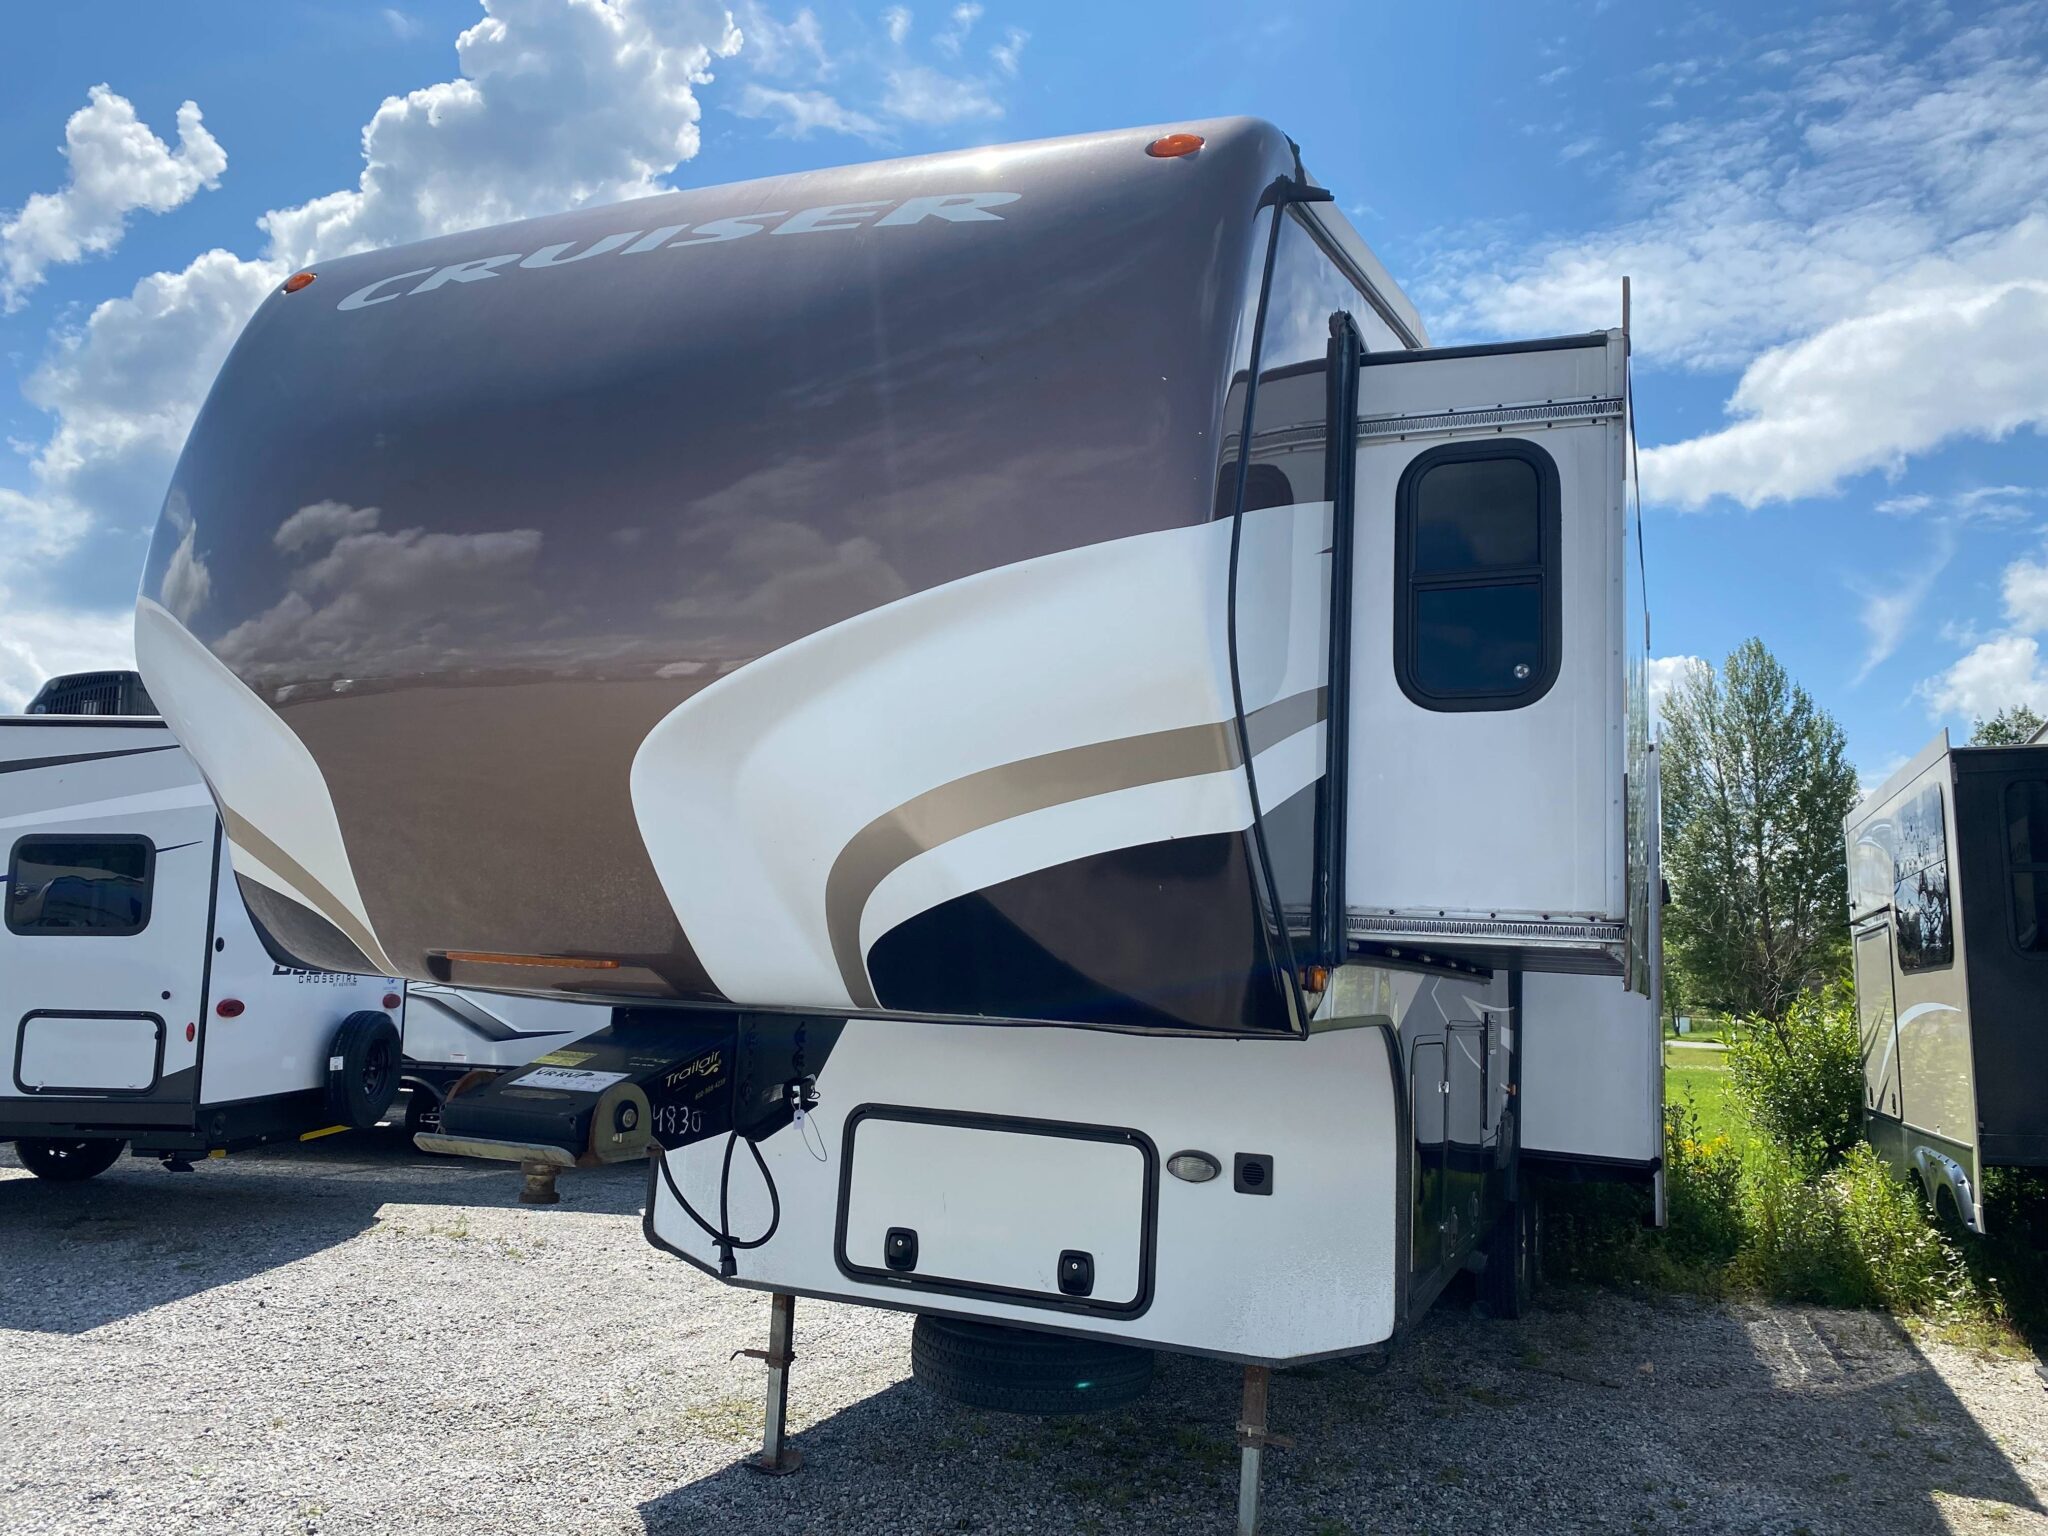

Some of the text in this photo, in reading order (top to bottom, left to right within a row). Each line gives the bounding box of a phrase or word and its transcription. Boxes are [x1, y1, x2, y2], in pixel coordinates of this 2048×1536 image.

[337, 191, 1022, 311] CRUISER
[298, 974, 358, 984] CROSSFIRE
[665, 1050, 720, 1087] Trailair
[652, 1104, 702, 1134] 4830
